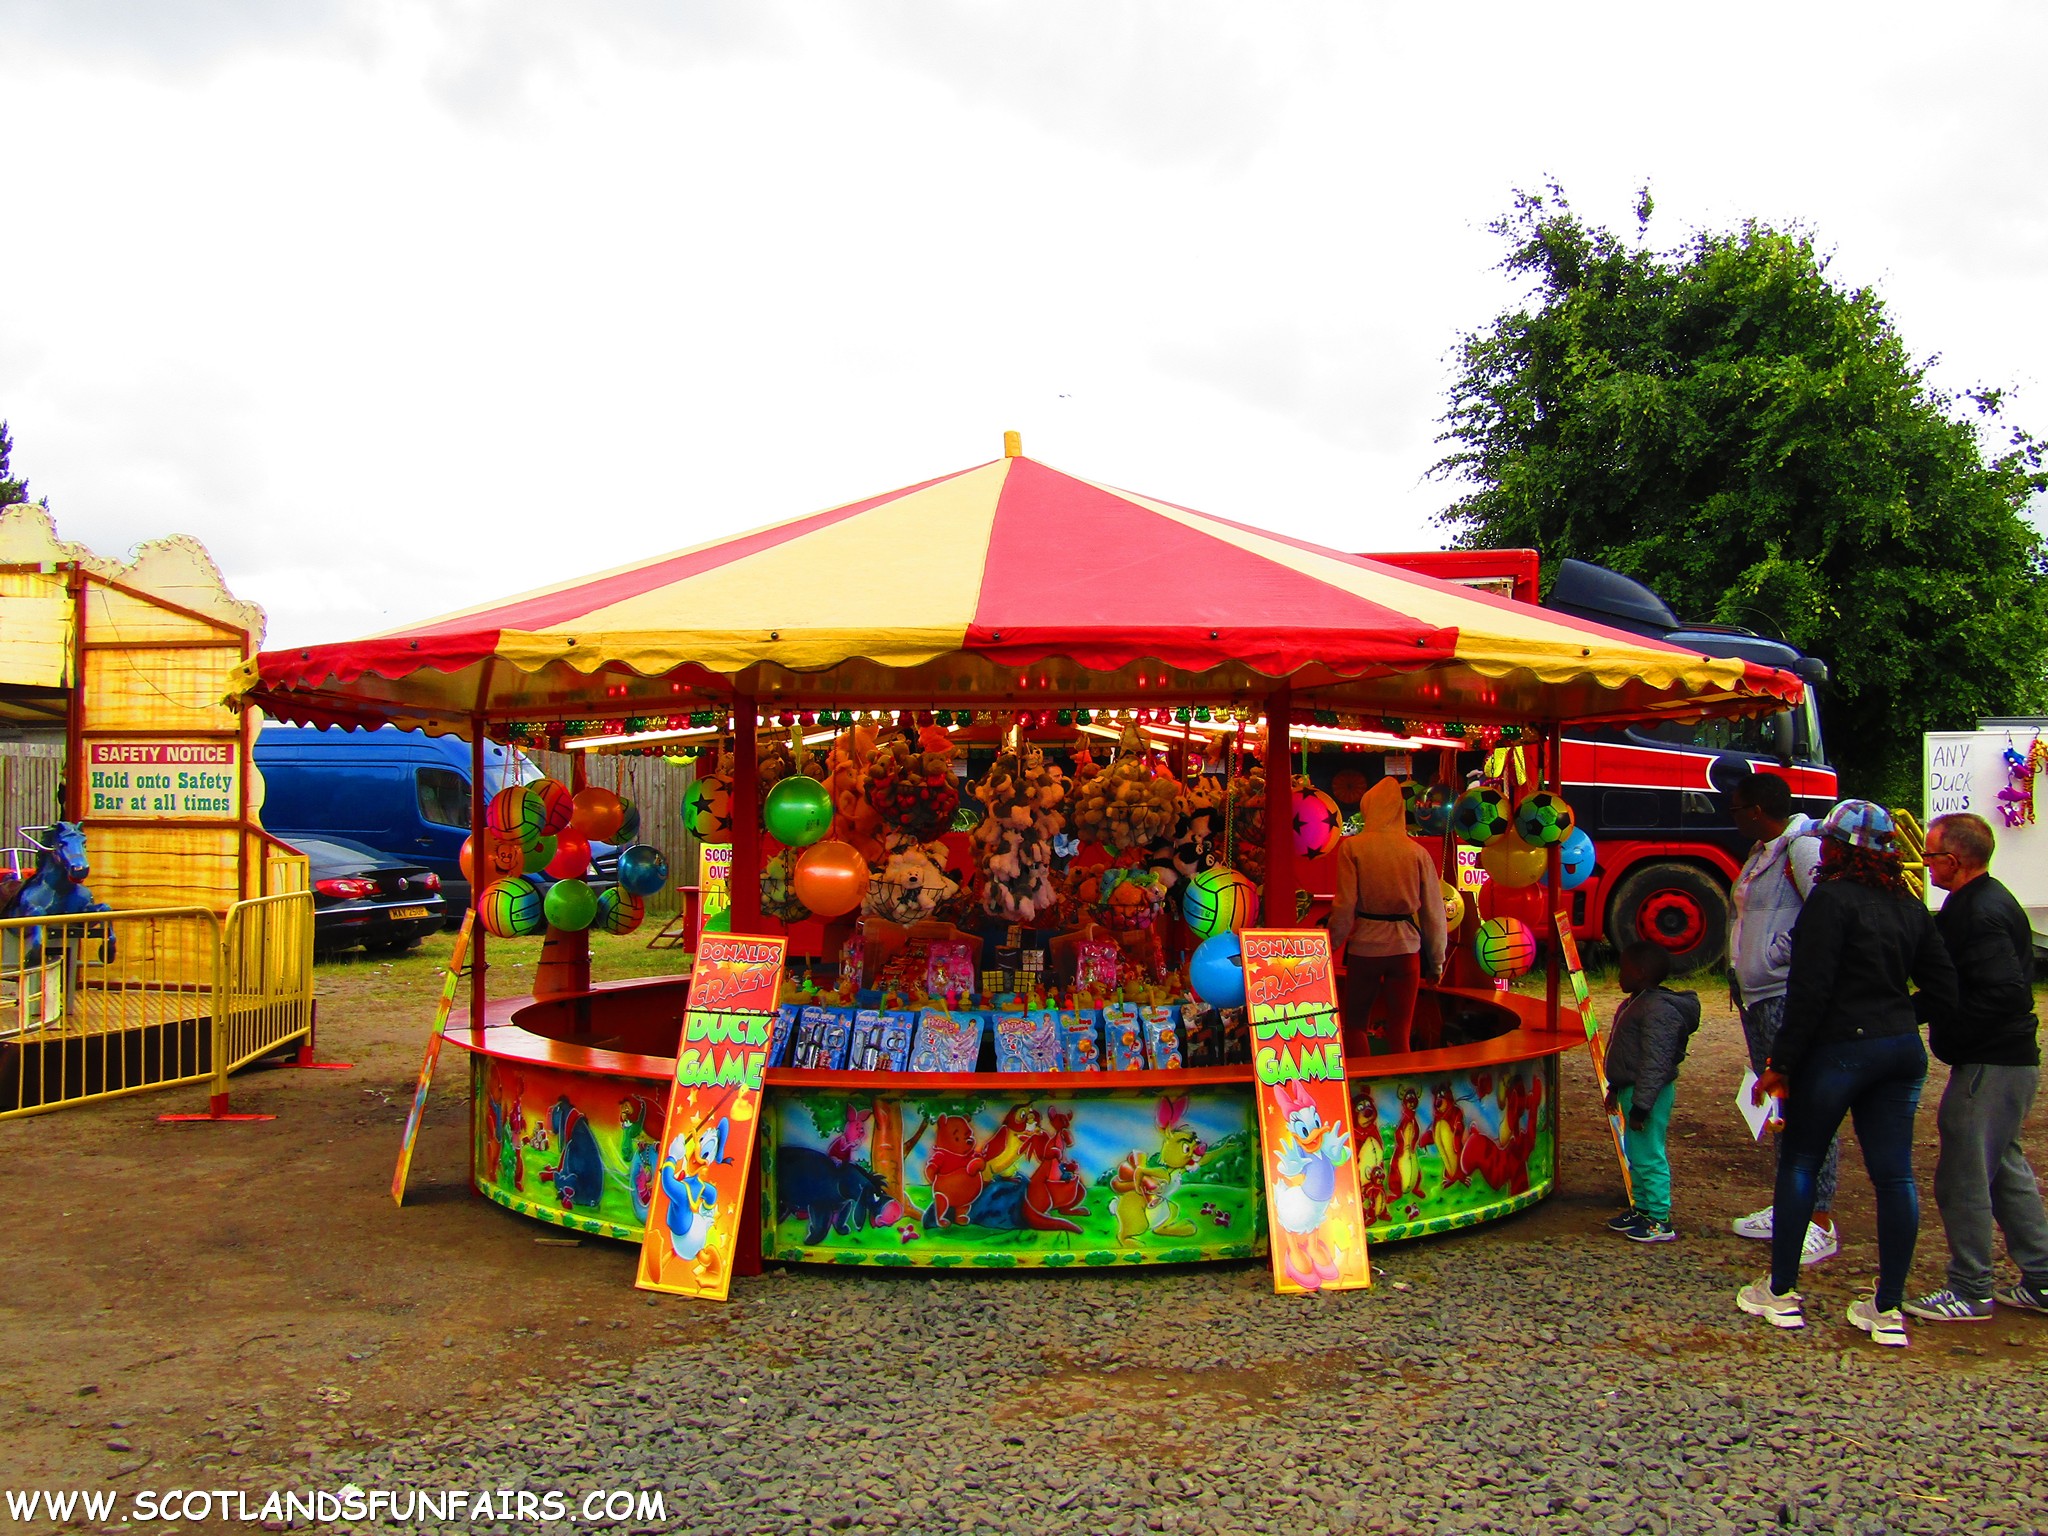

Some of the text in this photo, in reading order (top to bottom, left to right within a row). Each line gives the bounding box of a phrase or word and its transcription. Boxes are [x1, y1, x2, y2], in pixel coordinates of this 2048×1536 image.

[98, 746, 226, 762] SAFETY NOTICE
[1933, 744, 1970, 767] ANY
[92, 771, 232, 793] Hold onto Safety
[1931, 772, 1973, 792] DUCK
[94, 793, 230, 811] Bar at all times
[1932, 795, 1970, 812] WINS
[709, 866, 730, 879] OVE
[1463, 870, 1490, 885] OVE
[699, 942, 781, 964] DONALDS
[1244, 939, 1326, 958] DONALDS
[690, 962, 782, 1007] CRAZY
[1249, 954, 1330, 1006] CRAZY
[686, 1006, 773, 1047] DUCK
[1253, 1002, 1340, 1041] DUCK
[676, 1048, 767, 1090] GAME
[1255, 1043, 1345, 1086] GAME
